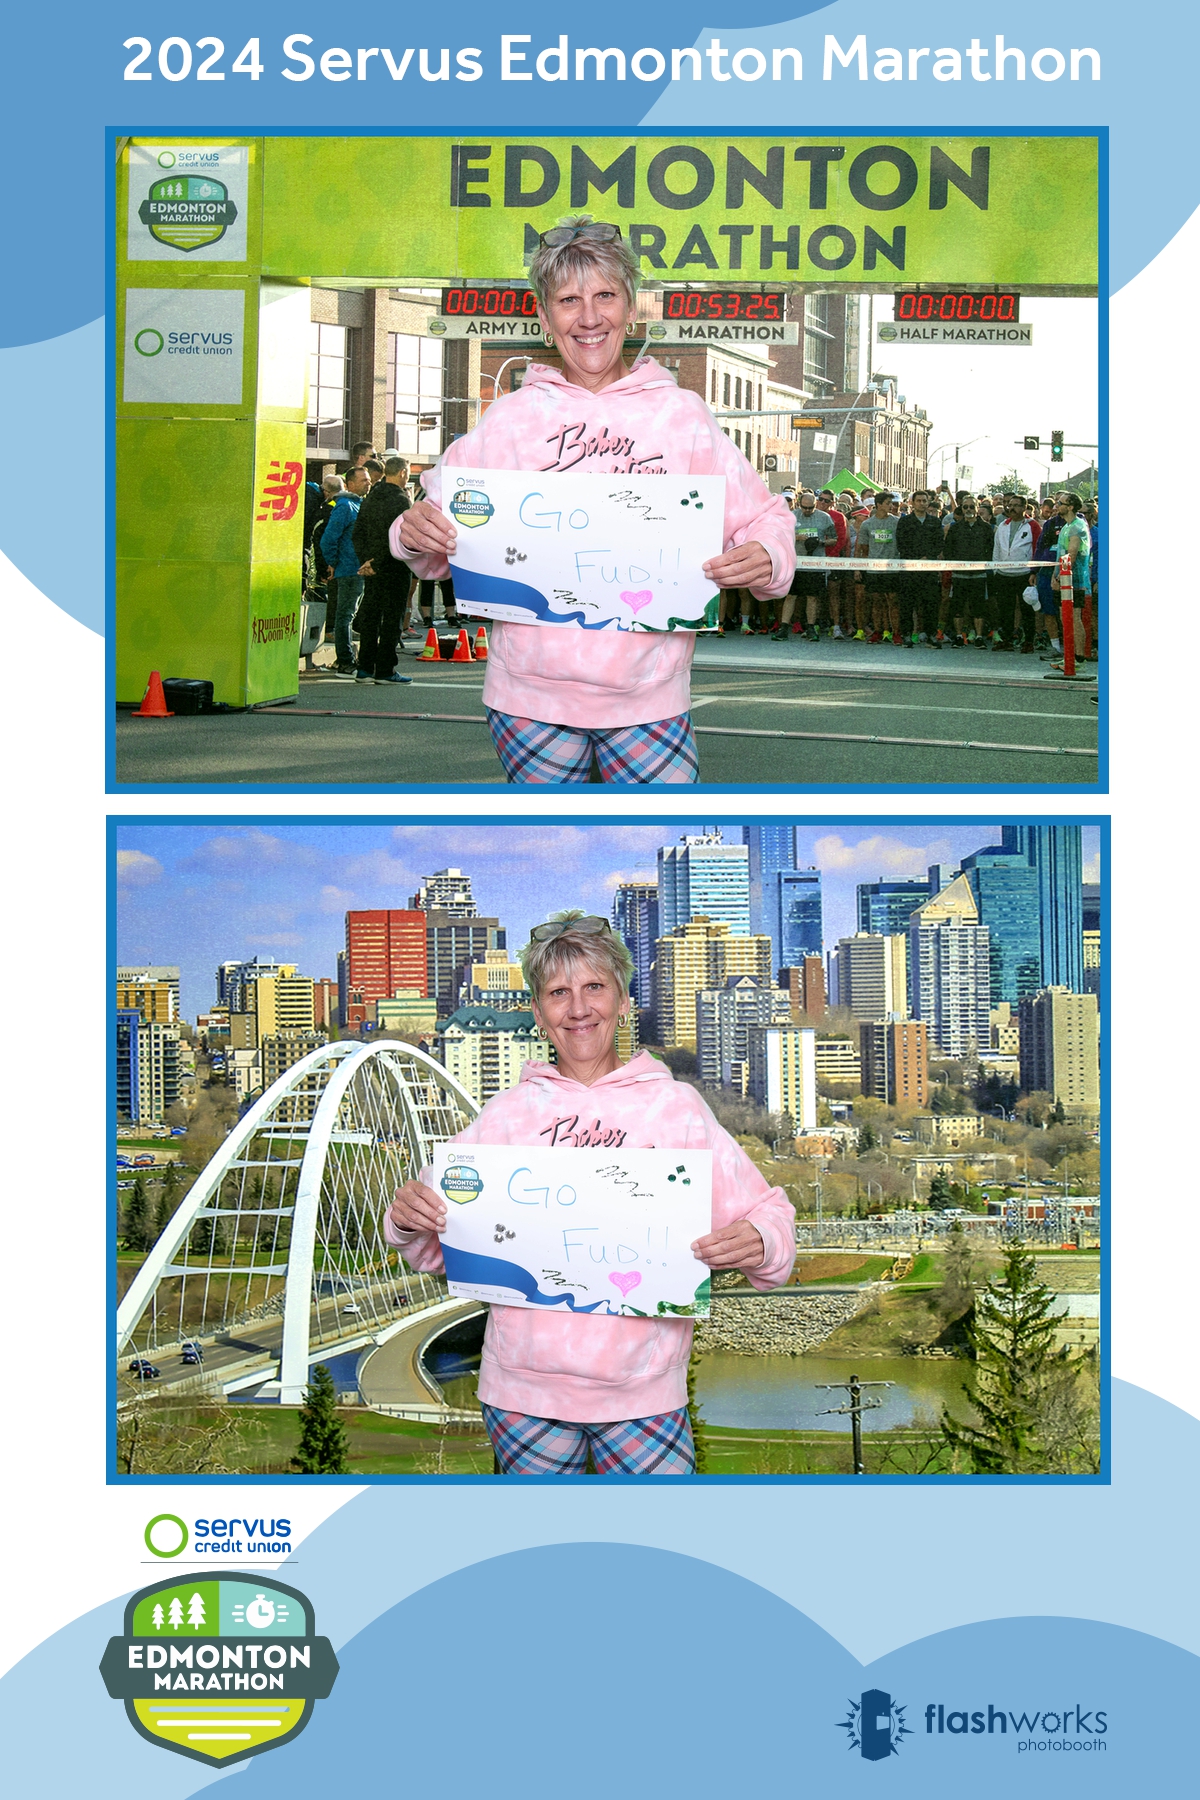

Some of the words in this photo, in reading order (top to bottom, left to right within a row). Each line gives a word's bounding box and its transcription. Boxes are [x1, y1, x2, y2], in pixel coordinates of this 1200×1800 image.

[178, 152, 220, 161] servus
[450, 145, 990, 211] EDMONTON
[149, 203, 227, 213] EDMONTON
[160, 214, 215, 222] MARATHON
[523, 222, 907, 271] RATHON
[466, 321, 518, 335] ARMY
[521, 322, 541, 336] 10
[678, 325, 785, 340] MARATHON
[900, 328, 939, 340] HALF
[942, 328, 1031, 341] MARATHON
[168, 332, 233, 345] servus
[168, 345, 200, 354] credit
[203, 347, 233, 355] union
[454, 502, 490, 510] EDMONTON
[257, 613, 291, 641] Running
[444, 1179, 479, 1187] EDMONTON
